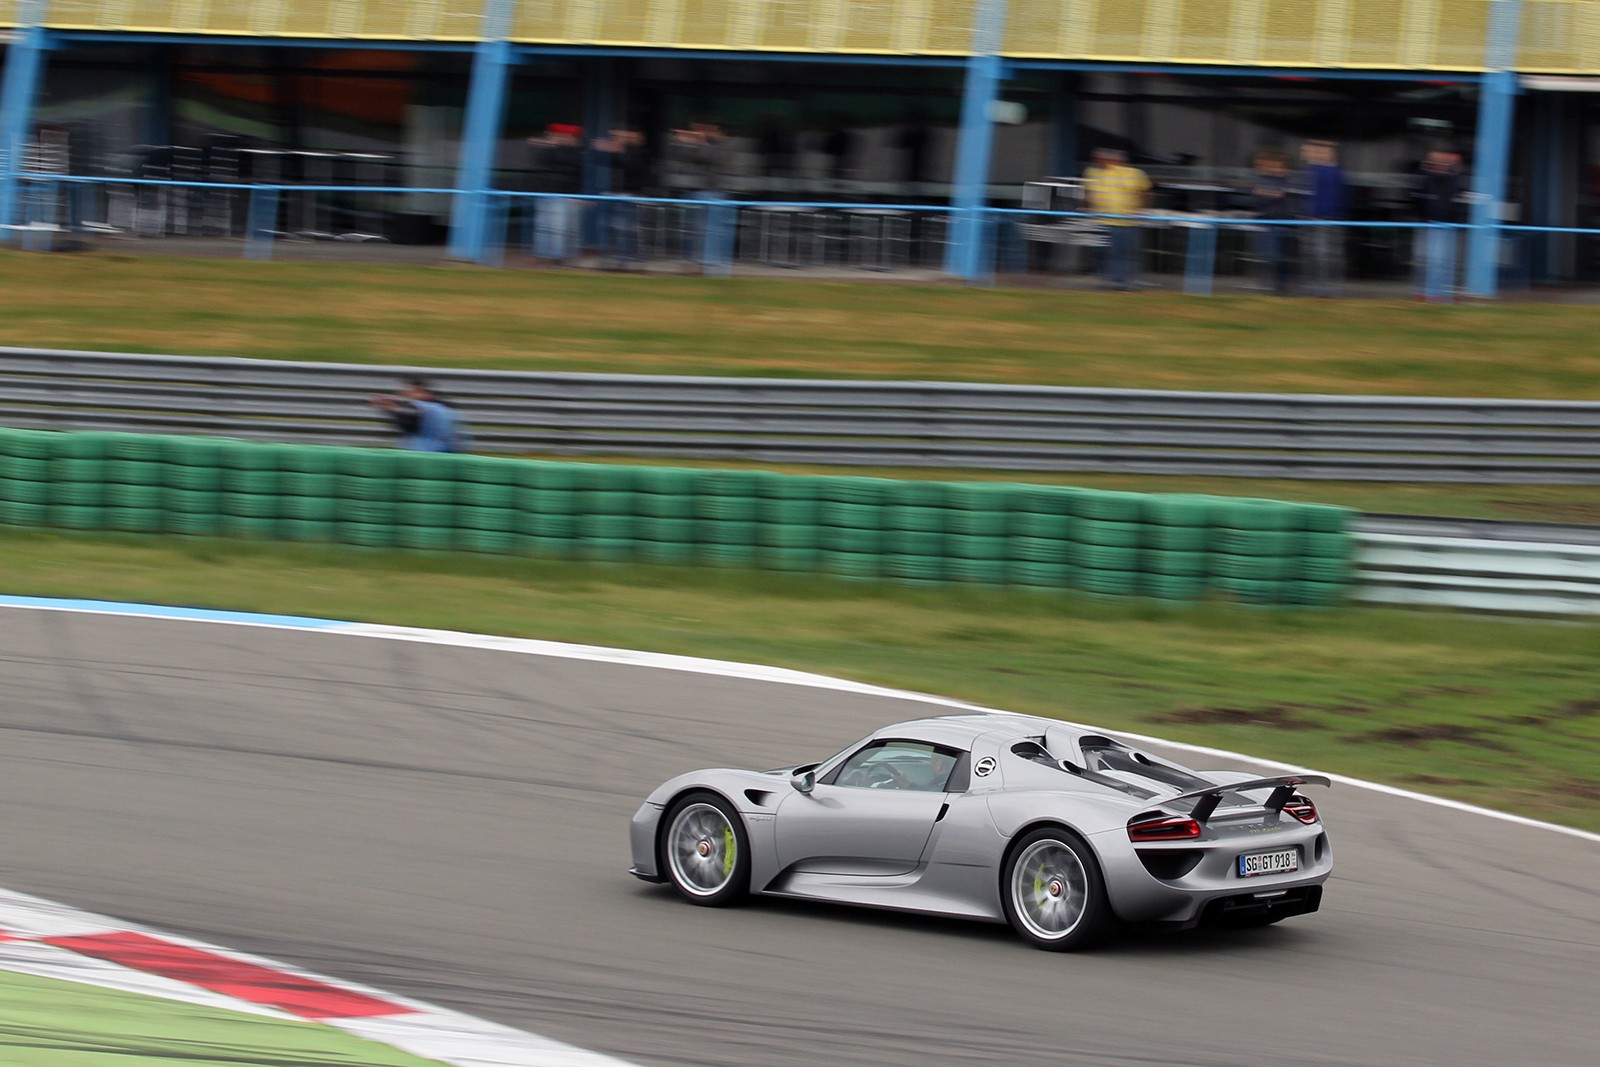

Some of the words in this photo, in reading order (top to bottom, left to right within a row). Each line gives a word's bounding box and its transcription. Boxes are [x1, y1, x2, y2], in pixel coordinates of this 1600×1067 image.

[1246, 857, 1257, 872] SG
[1262, 855, 1273, 870] GT
[1275, 853, 1290, 868] 918
